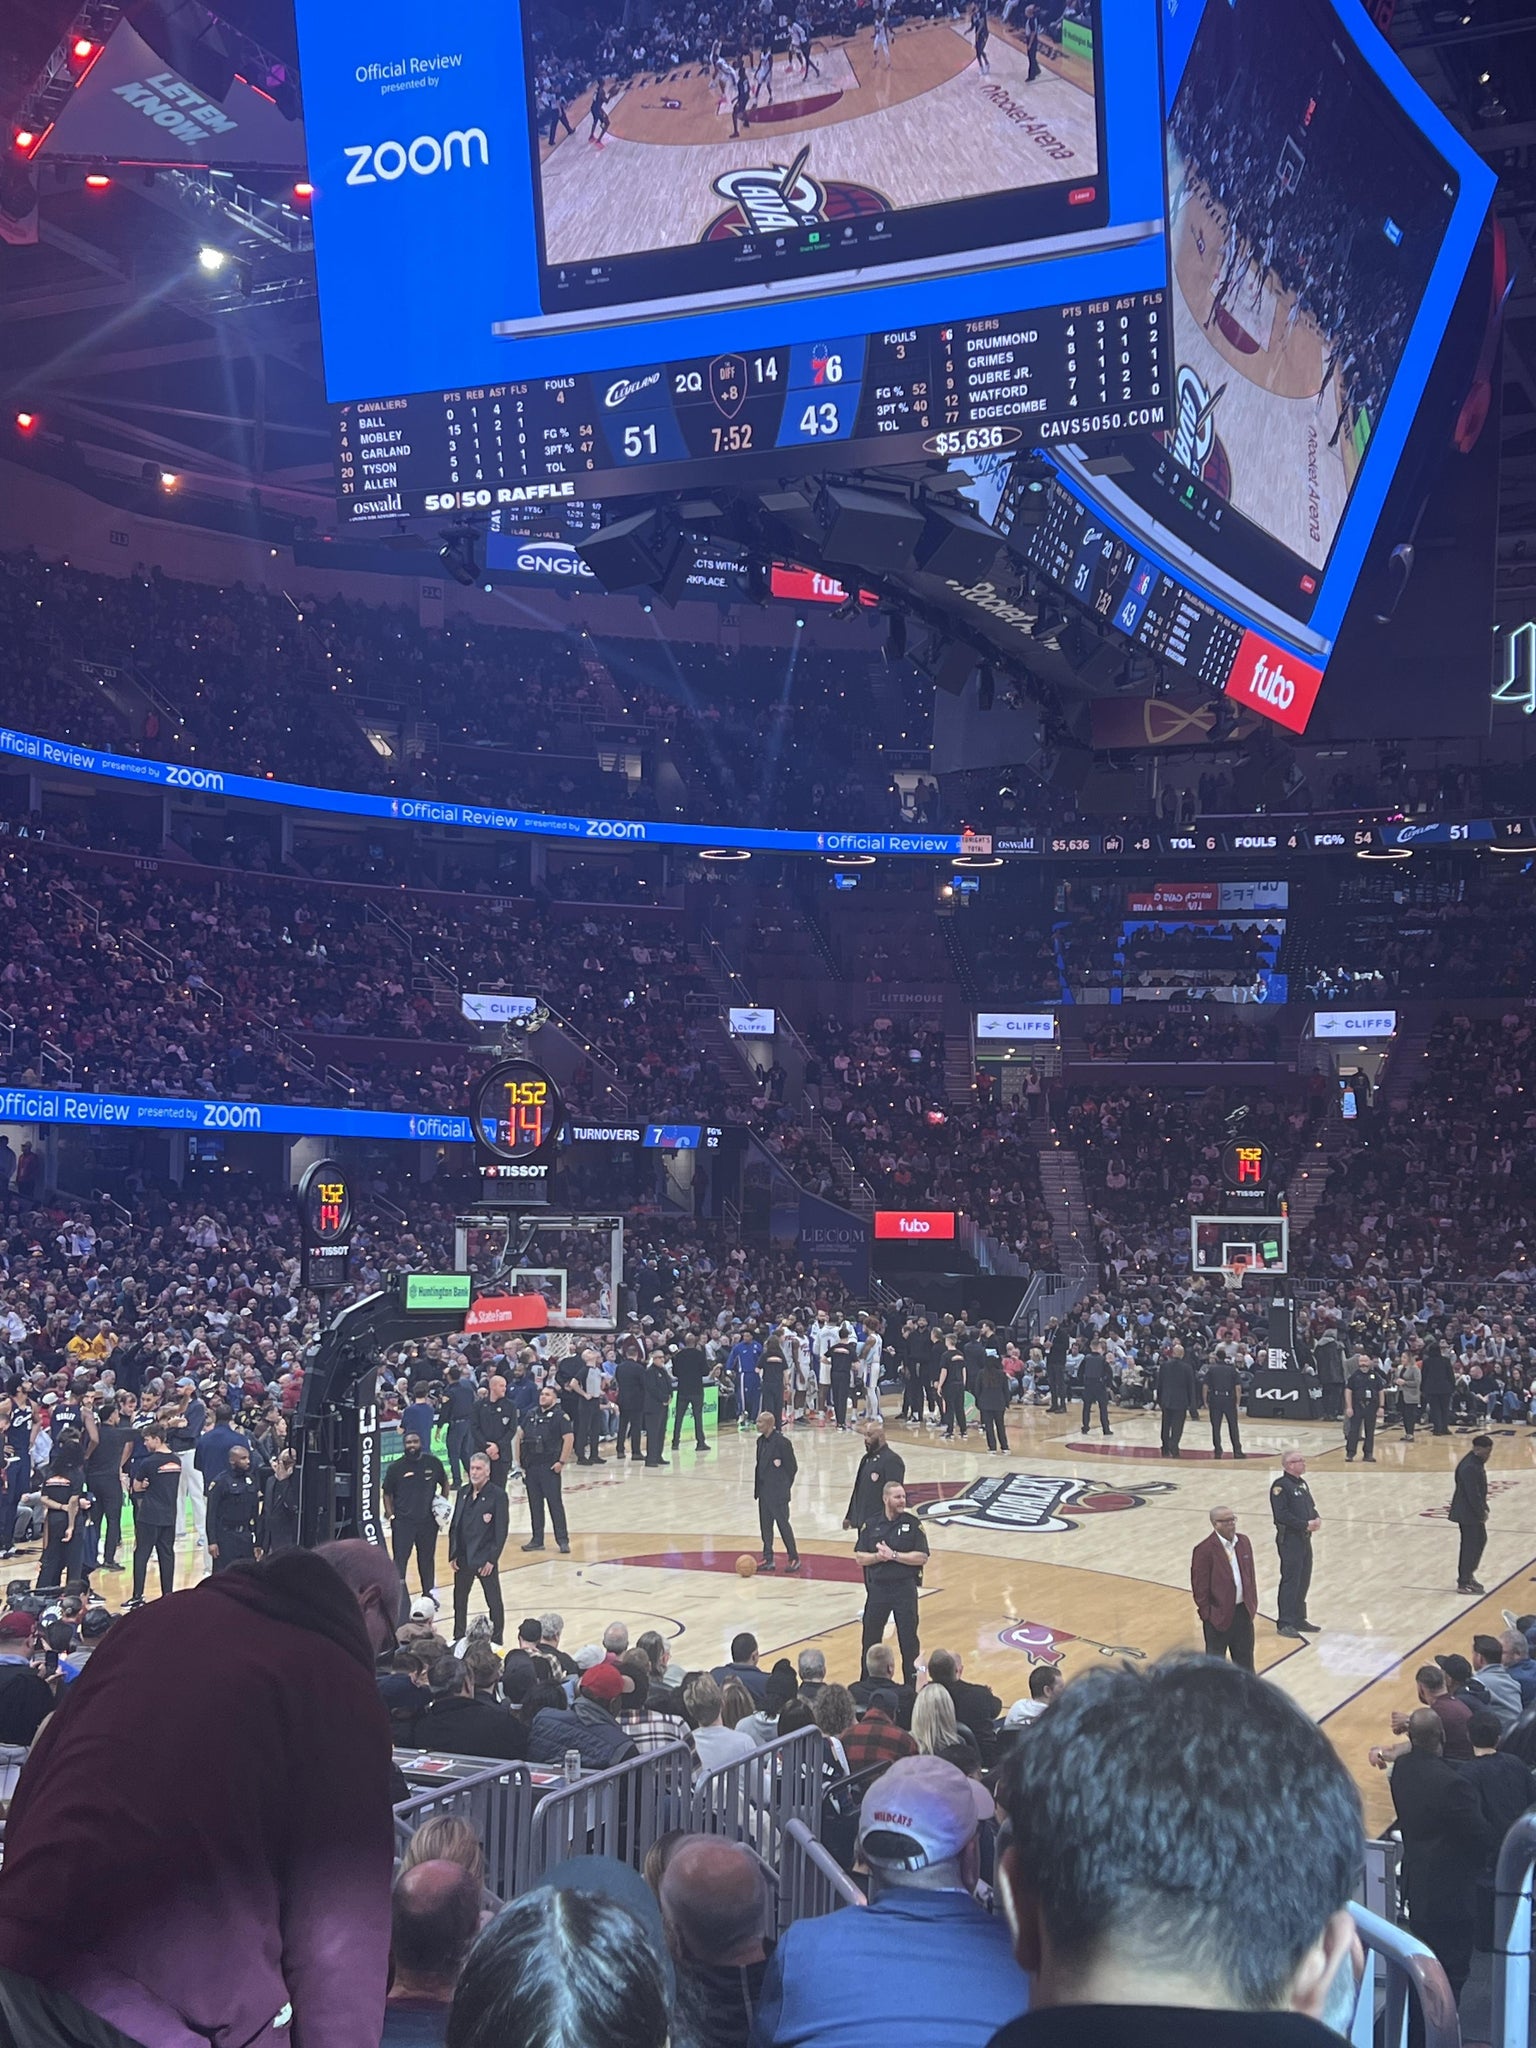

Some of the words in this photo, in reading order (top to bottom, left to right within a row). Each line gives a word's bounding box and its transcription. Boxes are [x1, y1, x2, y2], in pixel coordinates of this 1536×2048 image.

[356, 59, 406, 82] Official
[410, 53, 462, 74] Review
[145, 72, 206, 107] LET
[381, 77, 426, 96] presented
[428, 76, 439, 87] by
[112, 82, 210, 146] KNOW.
[991, 85, 1035, 124] Rocket
[1020, 124, 1074, 160] Arena
[343, 128, 489, 185] zoom
[966, 319, 999, 332] 76ERS
[1062, 306, 1082, 318] PTS
[1089, 302, 1110, 314] REB
[1116, 298, 1136, 310] AST
[1143, 294, 1162, 306] FLS
[884, 331, 916, 345] FOULS
[945, 344, 951, 355] 1
[967, 331, 1038, 351] DRUMMOND
[1067, 325, 1075, 336] 4
[1097, 321, 1104, 332] 3
[1120, 317, 1128, 328] 0
[1149, 312, 1157, 324] 0
[897, 346, 905, 358] 3
[755, 357, 777, 382] 14
[811, 355, 842, 384] 76
[946, 361, 953, 372] 5
[968, 352, 1014, 368] GRIMES
[676, 372, 702, 392] 2Q
[720, 366, 735, 379] DIFF
[946, 378, 954, 389] 9
[969, 370, 1010, 386] OUBRE
[1014, 367, 1032, 380] JR.
[545, 378, 574, 390] FOULS
[605, 372, 660, 407] CLEVELAND
[721, 386, 738, 400] +8
[876, 388, 891, 398] FG
[894, 386, 904, 397] %
[912, 383, 927, 395] 52
[357, 400, 407, 413] CAVALIERS
[444, 393, 461, 402] PTS
[466, 390, 484, 399] REB
[489, 387, 506, 397] AST
[511, 385, 527, 395] FLS
[557, 392, 564, 403] 4
[945, 395, 958, 407] 12
[970, 385, 1028, 402] WATFORD
[877, 404, 896, 416] 3PT
[898, 402, 908, 414] %
[913, 400, 928, 412] 40
[945, 412, 959, 424] 77
[970, 400, 1047, 420] EDGECOMBE
[340, 422, 347, 432] 2
[359, 418, 385, 429] BALL
[800, 403, 838, 436] 43
[878, 420, 899, 432] TOL
[921, 416, 928, 427] 6
[1041, 407, 1164, 438] CAVS5050.COM
[341, 437, 348, 447] 4
[361, 431, 401, 444] MOBLEY
[544, 429, 557, 439] FG
[560, 427, 569, 437] %
[580, 425, 592, 436] 54
[624, 424, 657, 457] 51
[711, 425, 752, 452] 7:52
[936, 426, 1002, 455] $5,636
[341, 452, 353, 462] 10
[362, 446, 410, 459] GARLAND
[545, 445, 562, 455] 3PT
[565, 443, 574, 453] %
[580, 441, 593, 452] 47
[341, 468, 354, 478] 20
[363, 463, 397, 475] TYSON
[546, 462, 565, 473] TOL
[586, 459, 593, 469] 6
[342, 483, 354, 493] 31
[364, 479, 397, 491] ALLEN
[498, 482, 574, 502] RAFFLE
[354, 494, 401, 513] oswald
[1309, 488, 1321, 543] Arena
[716, 560, 738, 571] WITH
[1124, 554, 1135, 574] 14
[1074, 564, 1090, 592] 51
[960, 582, 1038, 622] Rocket
[1121, 601, 1137, 628] 43
[1250, 654, 1295, 711] fubo
[43, 744, 94, 769] Review
[102, 759, 146, 775] presented
[148, 766, 160, 778] by
[166, 767, 224, 791] zoom
[402, 802, 458, 821] Official
[463, 809, 518, 828] Review
[525, 819, 567, 829] presented
[569, 822, 580, 831] by
[586, 821, 646, 839] zoom
[1314, 834, 1345, 846] FG%
[1354, 831, 1372, 844] 54
[1397, 822, 1439, 842] CLEVELAND
[1450, 824, 1468, 840] 51
[1506, 824, 1522, 835] 14
[827, 836, 886, 850] Official
[890, 836, 948, 851] Review
[998, 838, 1034, 849] oswald
[1052, 838, 1090, 851] $5,636
[1134, 838, 1150, 850] +8
[1170, 838, 1196, 850] TOL
[1206, 837, 1215, 850] 6
[1235, 836, 1276, 848] FOULS
[1288, 836, 1297, 848] 4
[881, 994, 943, 1002] LITEHOUSE
[490, 1003, 532, 1014] CLIFFS
[1006, 1021, 1050, 1031] CLIFFS
[1344, 1018, 1392, 1029] CLIFFS
[504, 1082, 547, 1104] 7:52
[65, 1099, 129, 1120] Review
[138, 1106, 183, 1118] presented
[183, 1108, 197, 1121] by
[203, 1104, 261, 1128] zoom
[417, 1119, 465, 1137] Official
[510, 1106, 542, 1147] 14
[573, 1128, 640, 1141] TURNOVERS
[654, 1129, 662, 1144] 7
[707, 1137, 719, 1147] 52
[1236, 1148, 1262, 1160] 7:52
[497, 1165, 548, 1177] TISSOT
[1239, 1160, 1261, 1182] 14
[318, 1184, 345, 1203] 7:52
[320, 1205, 339, 1230] 14
[900, 1218, 930, 1233] fubo
[321, 1245, 349, 1257] TISSOT
[418, 1286, 451, 1299] Huntington
[453, 1286, 469, 1298] Bank
[362, 1436, 373, 1521] Cleveland
[874, 1810, 913, 1828] WILDCATS
